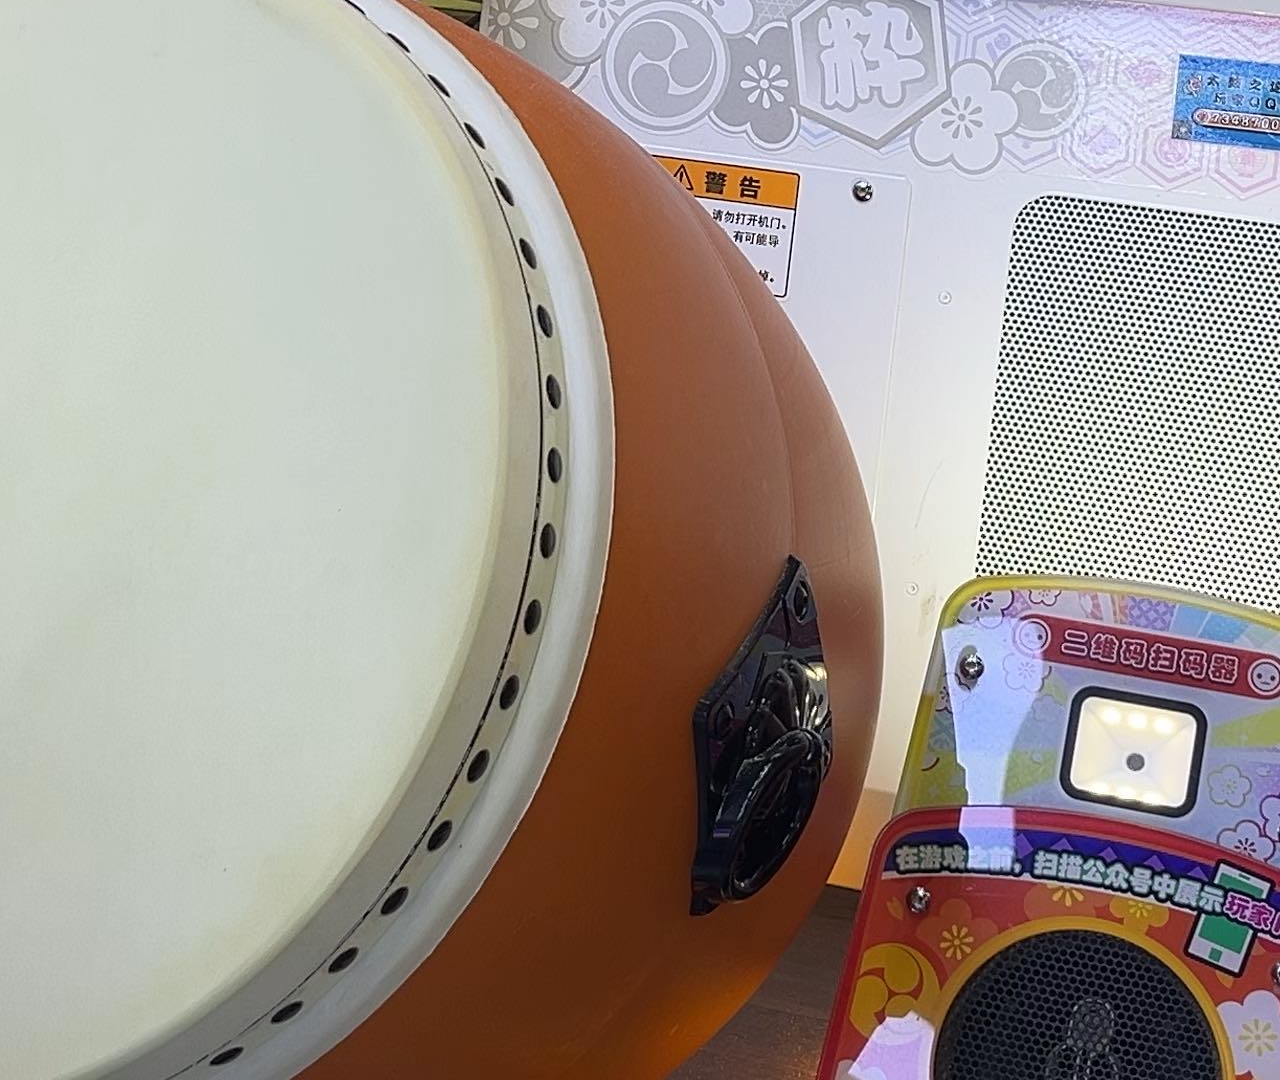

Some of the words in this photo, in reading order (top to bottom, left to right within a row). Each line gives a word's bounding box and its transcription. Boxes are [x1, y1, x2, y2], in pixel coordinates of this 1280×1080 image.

[704, 170, 762, 200] 警告
[732, 230, 780, 248] 有可能导
[1060, 631, 1240, 685] 二维码扫码器
